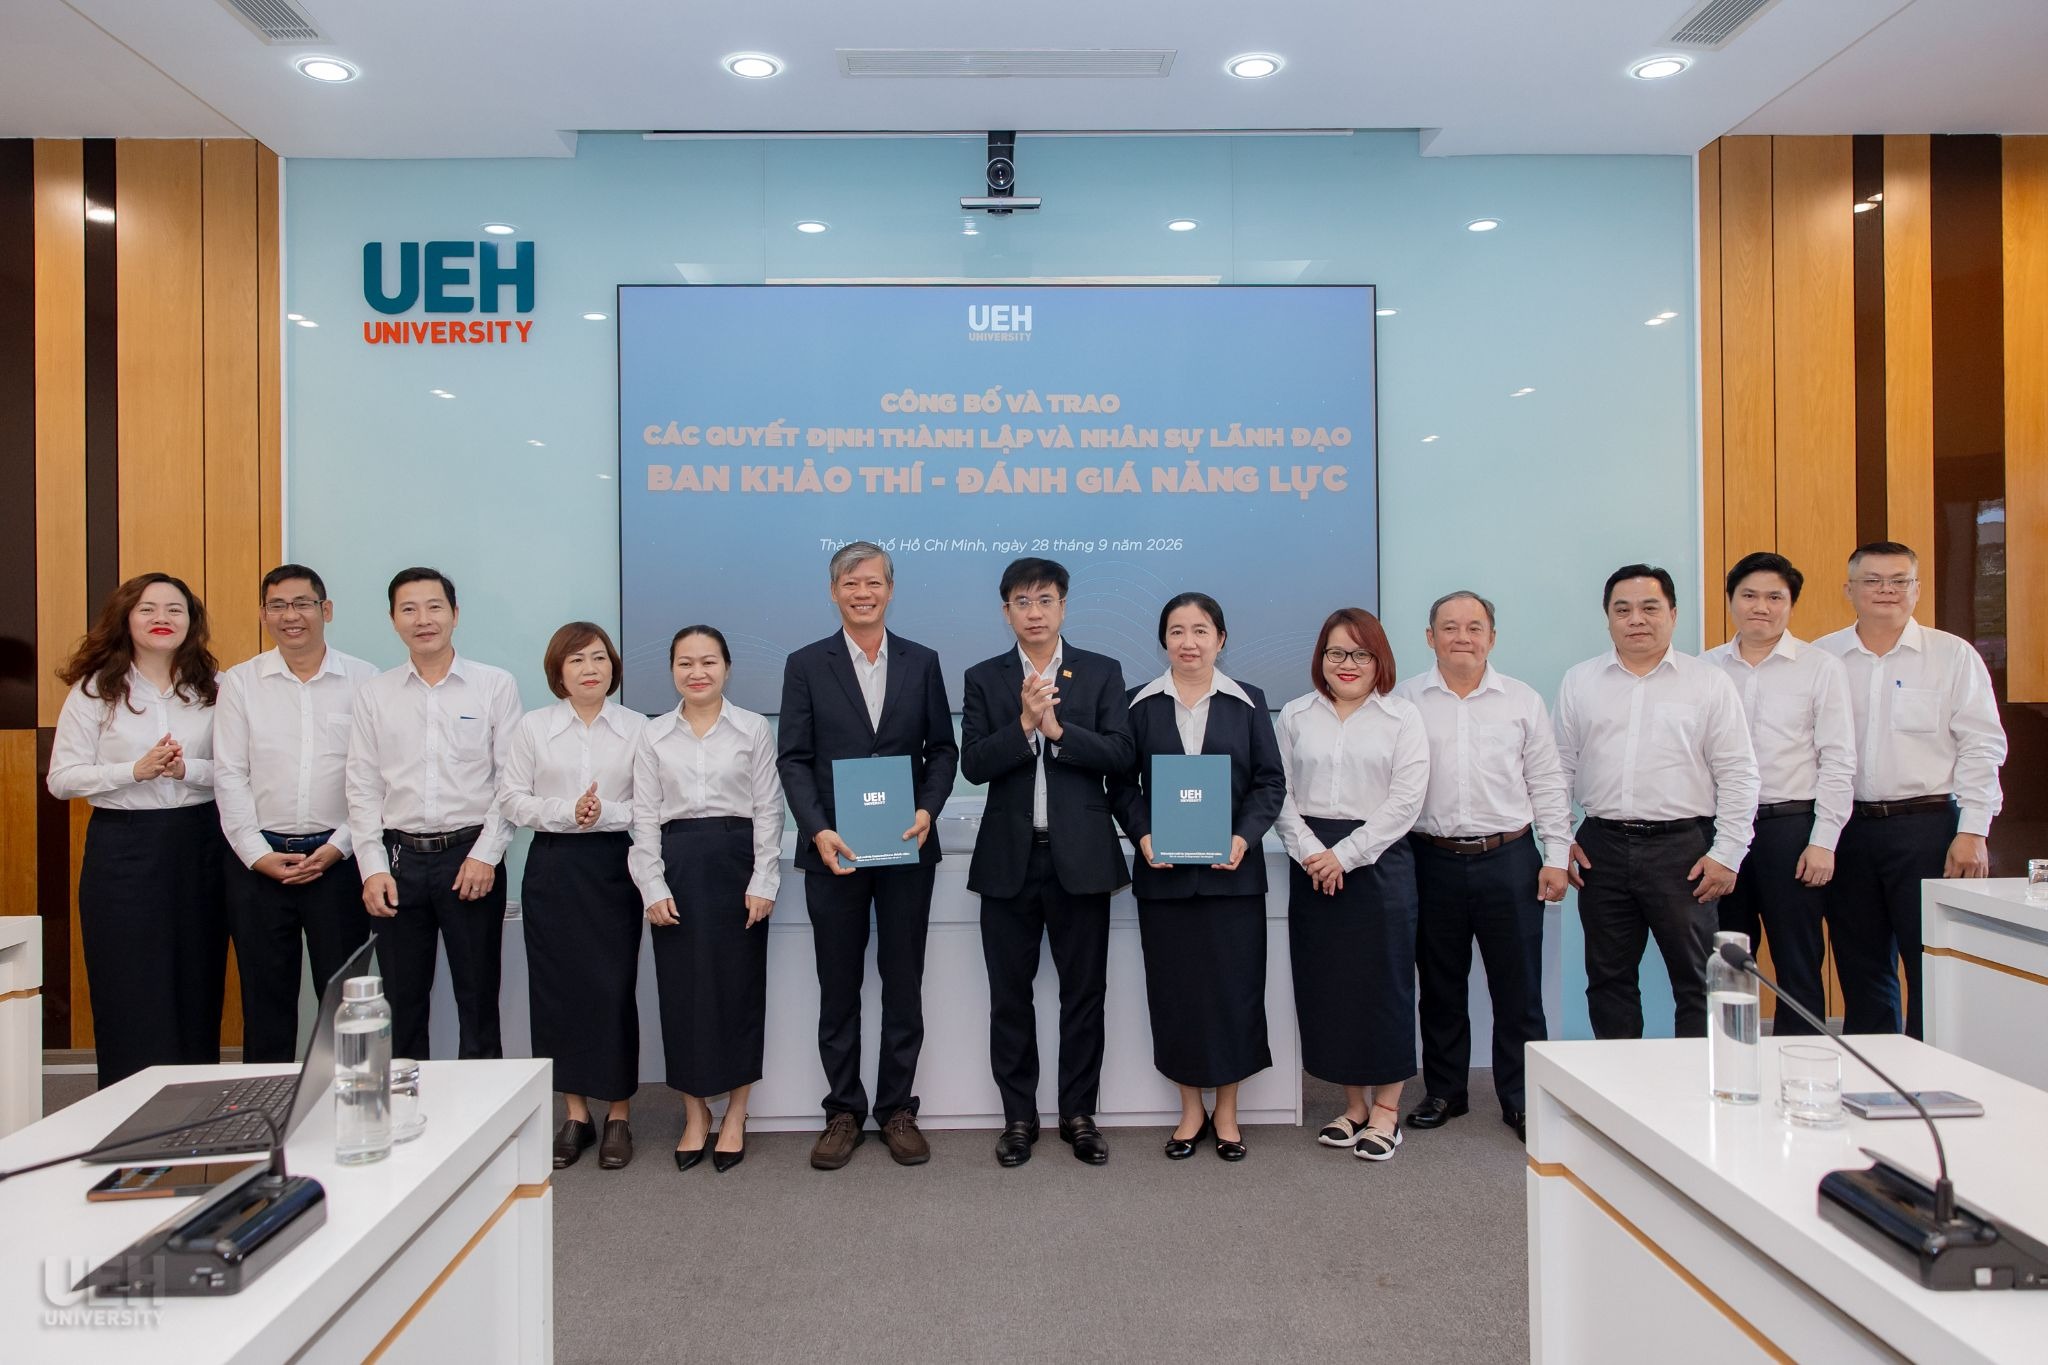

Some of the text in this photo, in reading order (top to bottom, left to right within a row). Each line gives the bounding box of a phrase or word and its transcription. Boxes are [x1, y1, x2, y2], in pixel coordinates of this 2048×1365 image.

[363, 241, 535, 315] UEH
[968, 304, 1033, 332] UEH
[363, 320, 533, 344] UNIVERSITY
[968, 332, 1032, 342] UNIVERSITY
[880, 384, 1121, 413] CÔNG BỐ VÀ TRAO
[643, 417, 1352, 454] CÁC QUYẾT ĐỊNH THÀNH LẬP VÀ NHÂN SỰ LÃNH ĐẠO
[647, 464, 731, 492] BAN
[740, 458, 852, 494] KHẢO
[858, 460, 925, 494] THÍ
[956, 460, 1068, 494] ĐÁNH
[1075, 460, 1142, 494] GIÁ
[1151, 459, 1260, 493] NĂNG
[1269, 464, 1349, 501] LỰC
[901, 537, 920, 551] Hồ
[924, 538, 949, 551] Chí
[951, 539, 988, 553] Minh,
[992, 539, 1028, 553] ngày
[1031, 539, 1050, 551] 28
[1053, 539, 1094, 554] tháng
[1098, 539, 1108, 551] 9
[1112, 540, 1143, 551] năm
[1146, 539, 1184, 551] 2026
[863, 792, 886, 803] UEH
[1180, 789, 1202, 800] UEH
